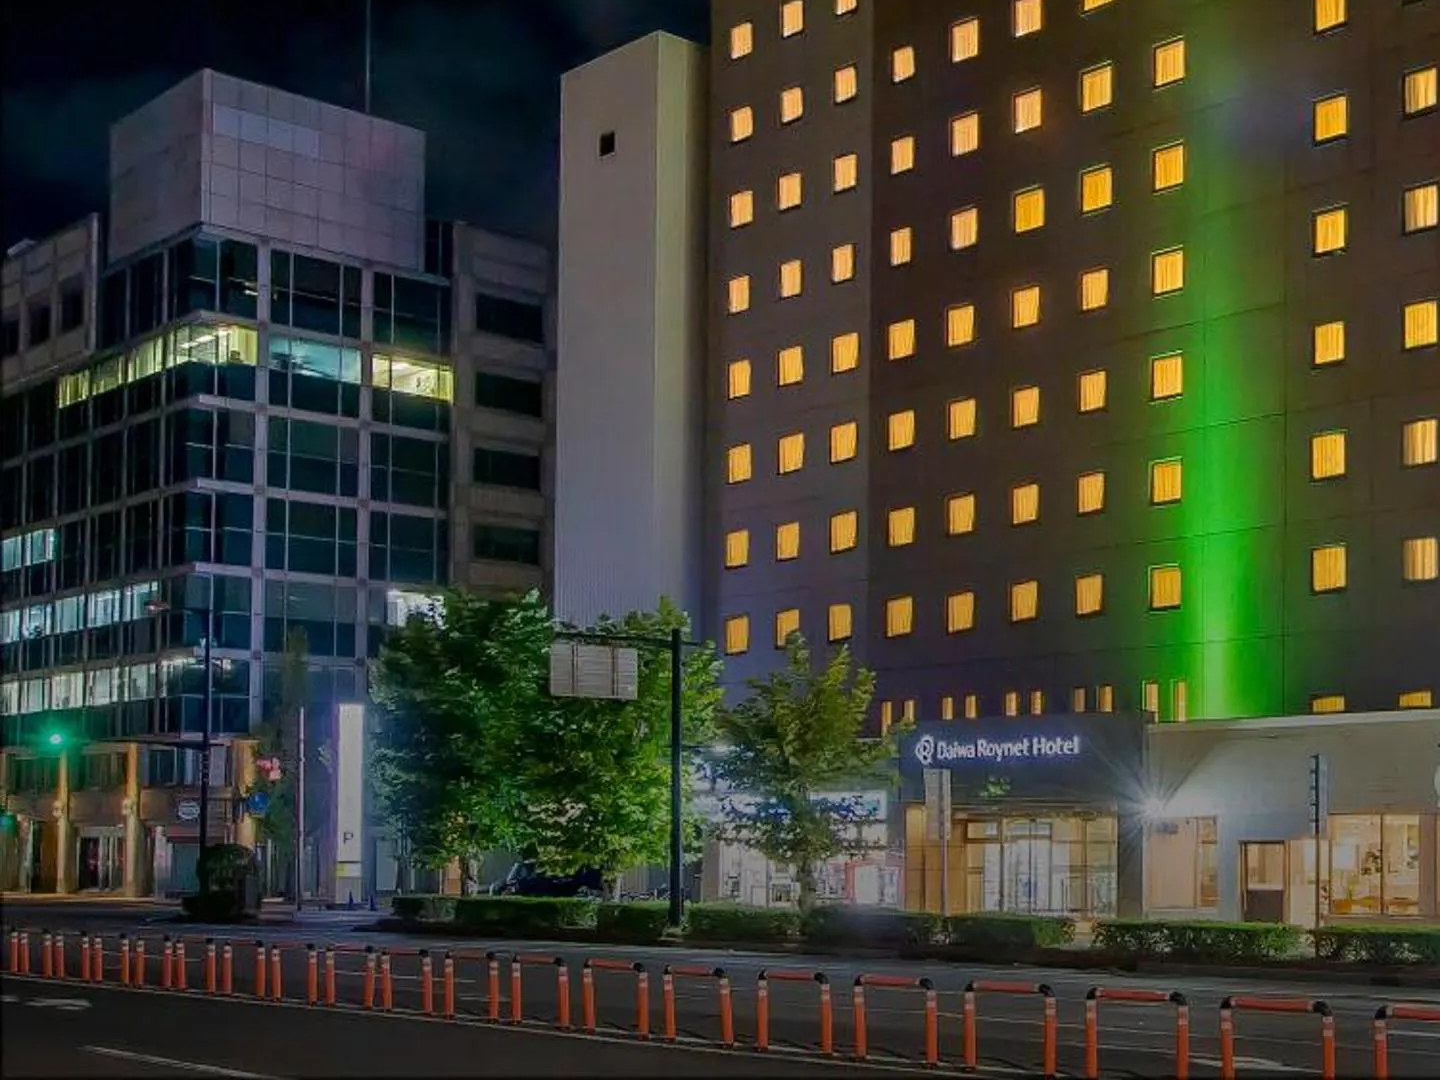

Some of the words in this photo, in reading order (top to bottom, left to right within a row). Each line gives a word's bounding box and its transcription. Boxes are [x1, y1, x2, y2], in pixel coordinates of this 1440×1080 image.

[937, 740, 976, 759] Daiwa
[977, 738, 1030, 761] Roynet
[1032, 735, 1079, 755] Hotel
